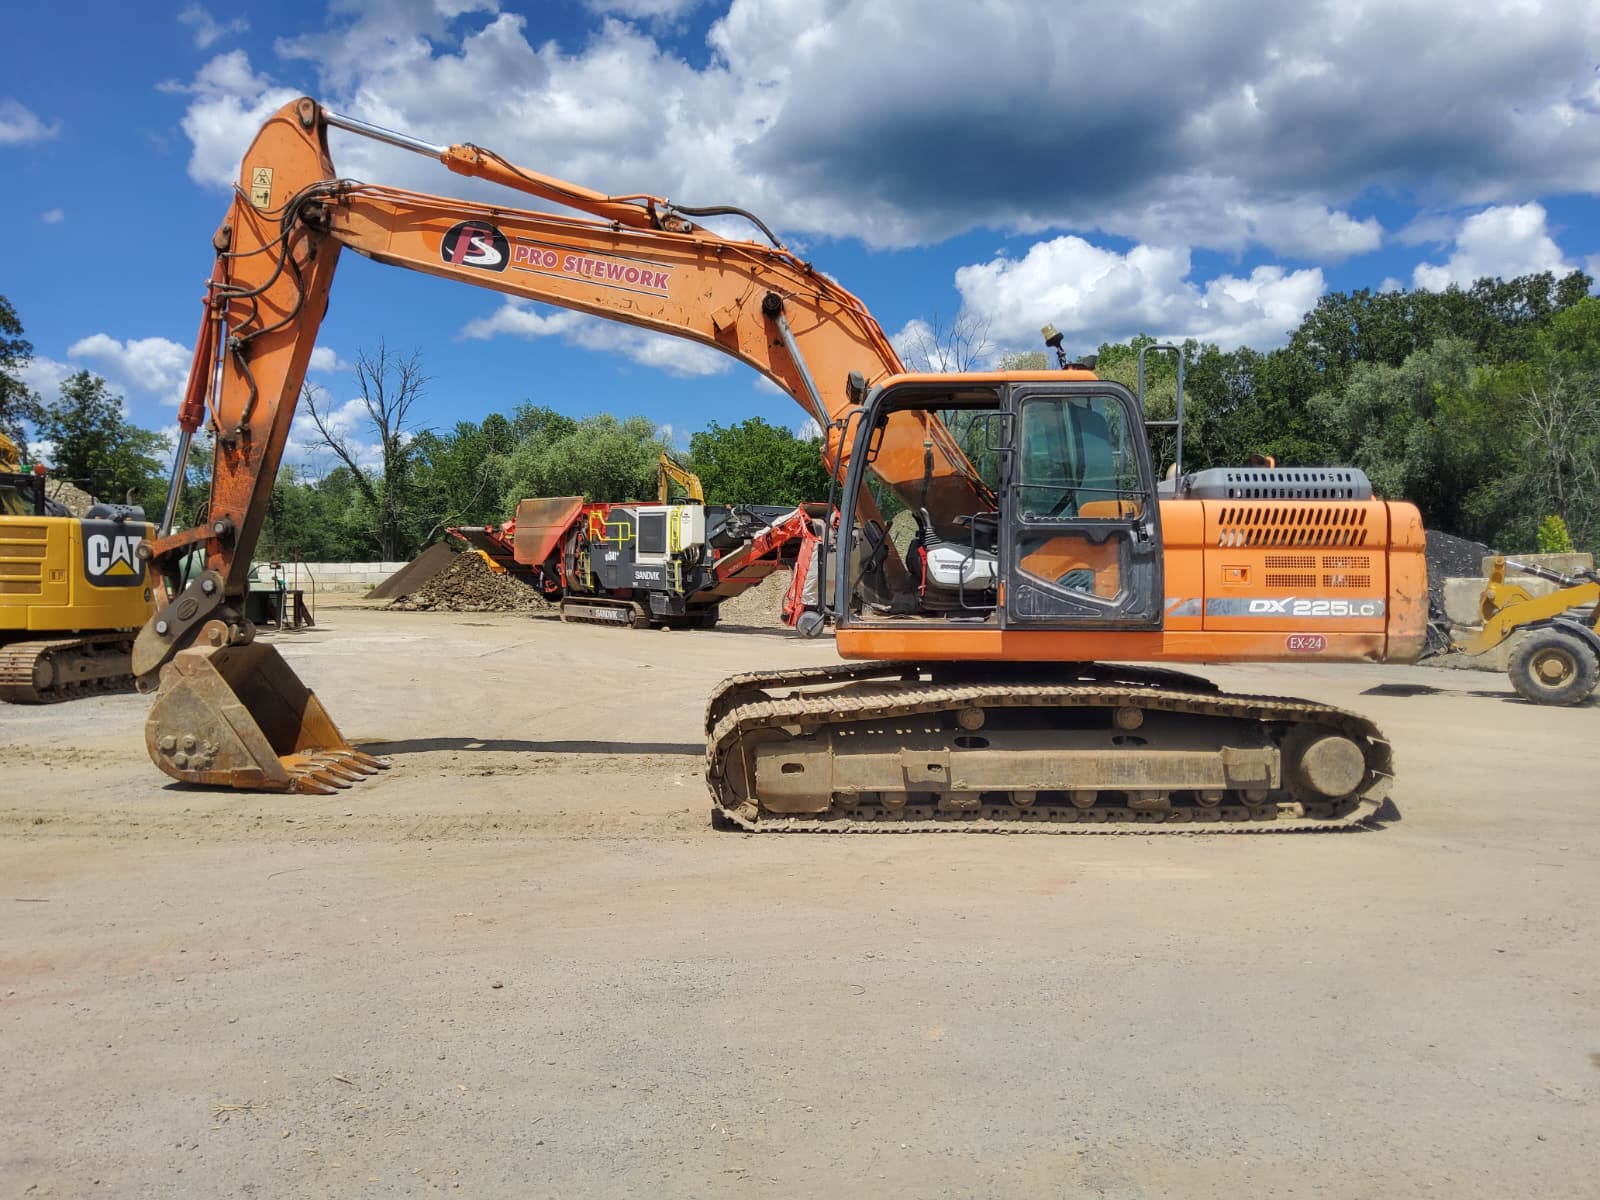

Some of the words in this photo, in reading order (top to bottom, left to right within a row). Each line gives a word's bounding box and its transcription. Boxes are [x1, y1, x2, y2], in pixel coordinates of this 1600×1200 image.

[515, 244, 558, 268] PRO
[564, 255, 669, 290] SITEWORK
[87, 534, 142, 575] CAT
[634, 571, 660, 580] SANDVIK
[1248, 597, 1296, 612] DX
[1290, 637, 1322, 649] EX-24
